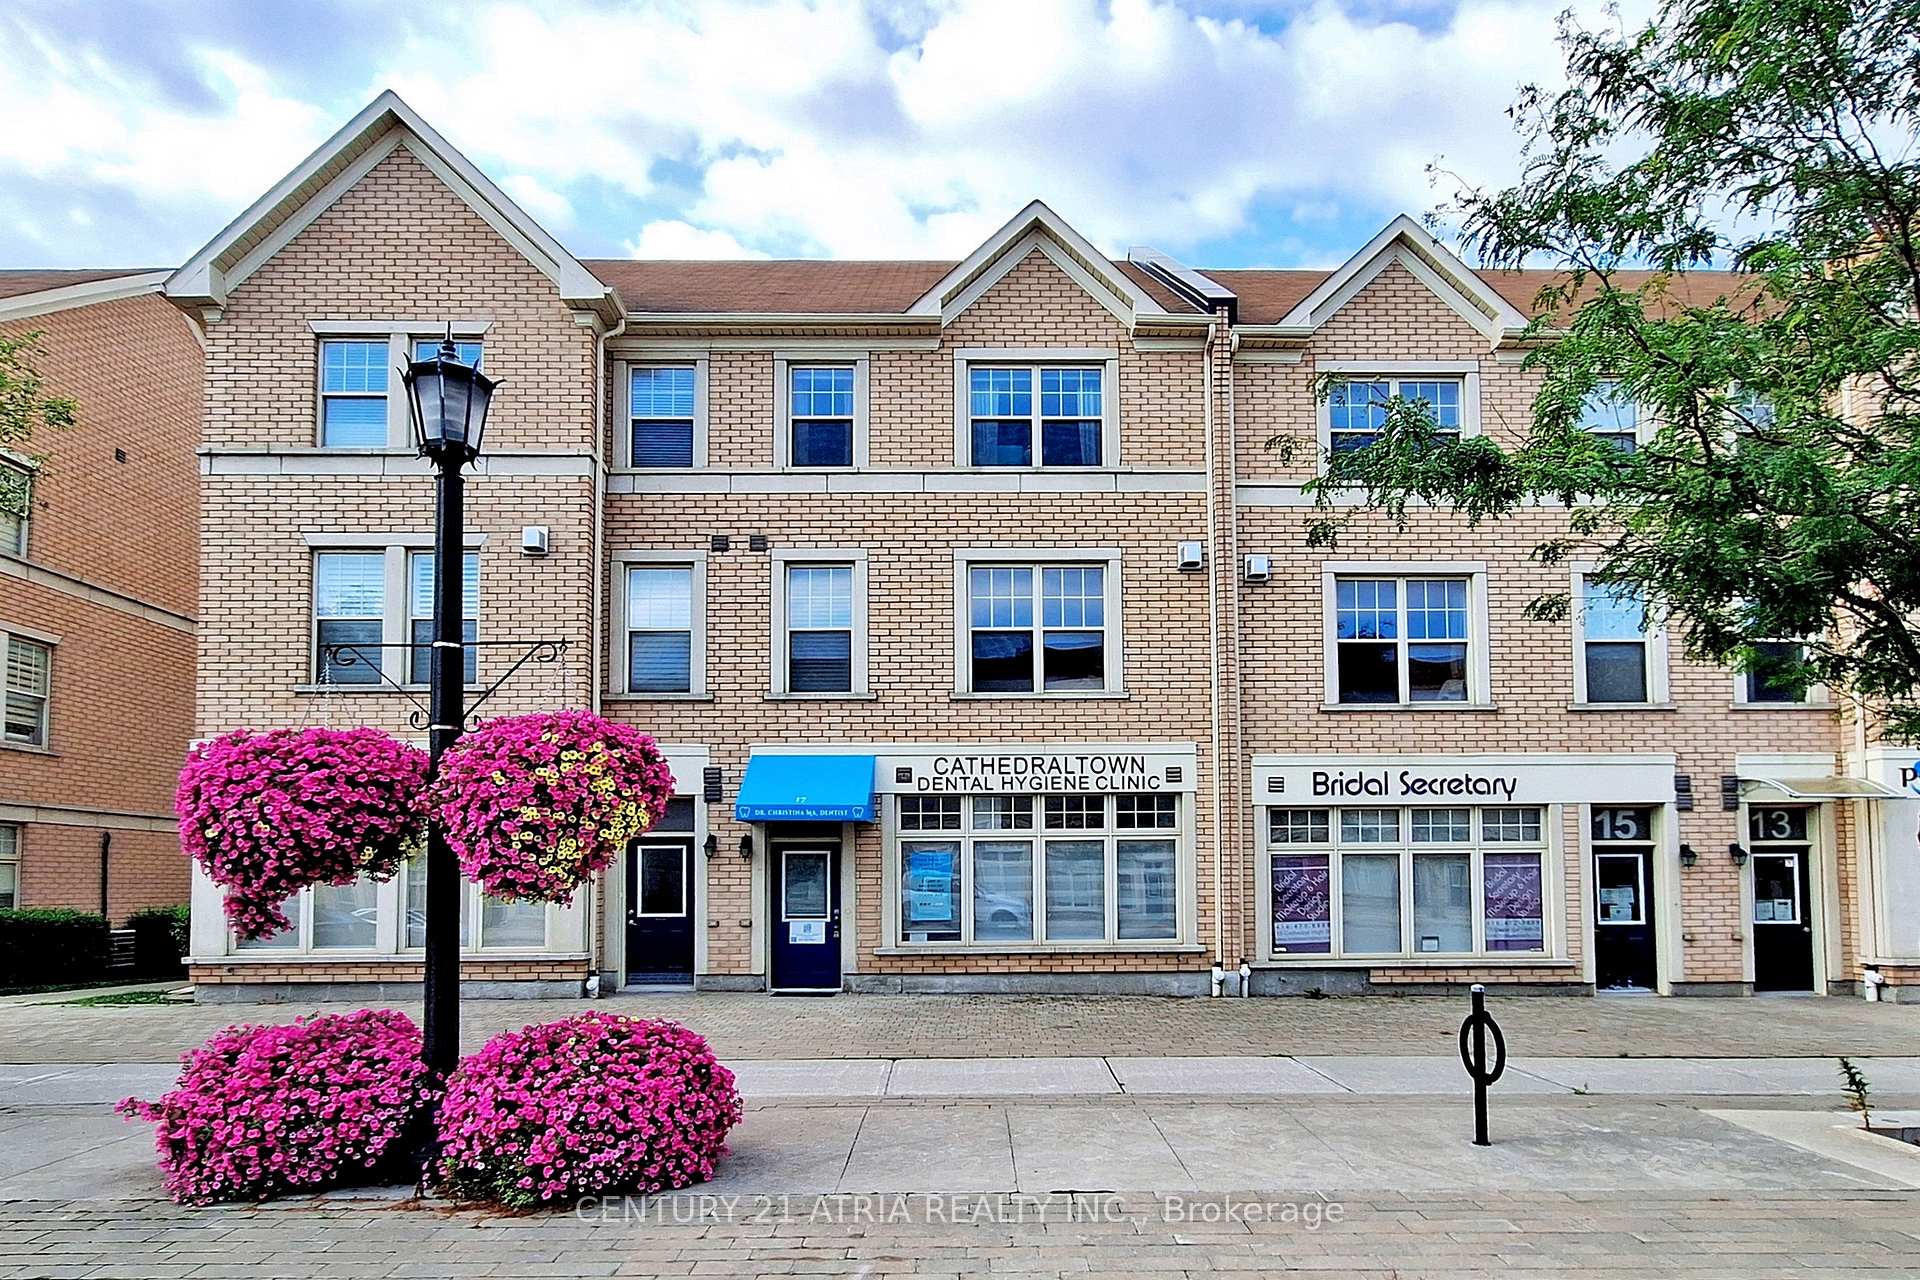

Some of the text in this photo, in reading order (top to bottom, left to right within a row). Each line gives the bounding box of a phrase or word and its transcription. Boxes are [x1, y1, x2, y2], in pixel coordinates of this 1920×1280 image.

[933, 756, 1145, 775] CATHEDRALTOWN
[917, 775, 1161, 791] DENTAL HYGIENE CLINIC
[1312, 770, 1518, 802] Bridal Secretary
[1594, 809, 1637, 839] 15
[1751, 810, 1791, 839] 13
